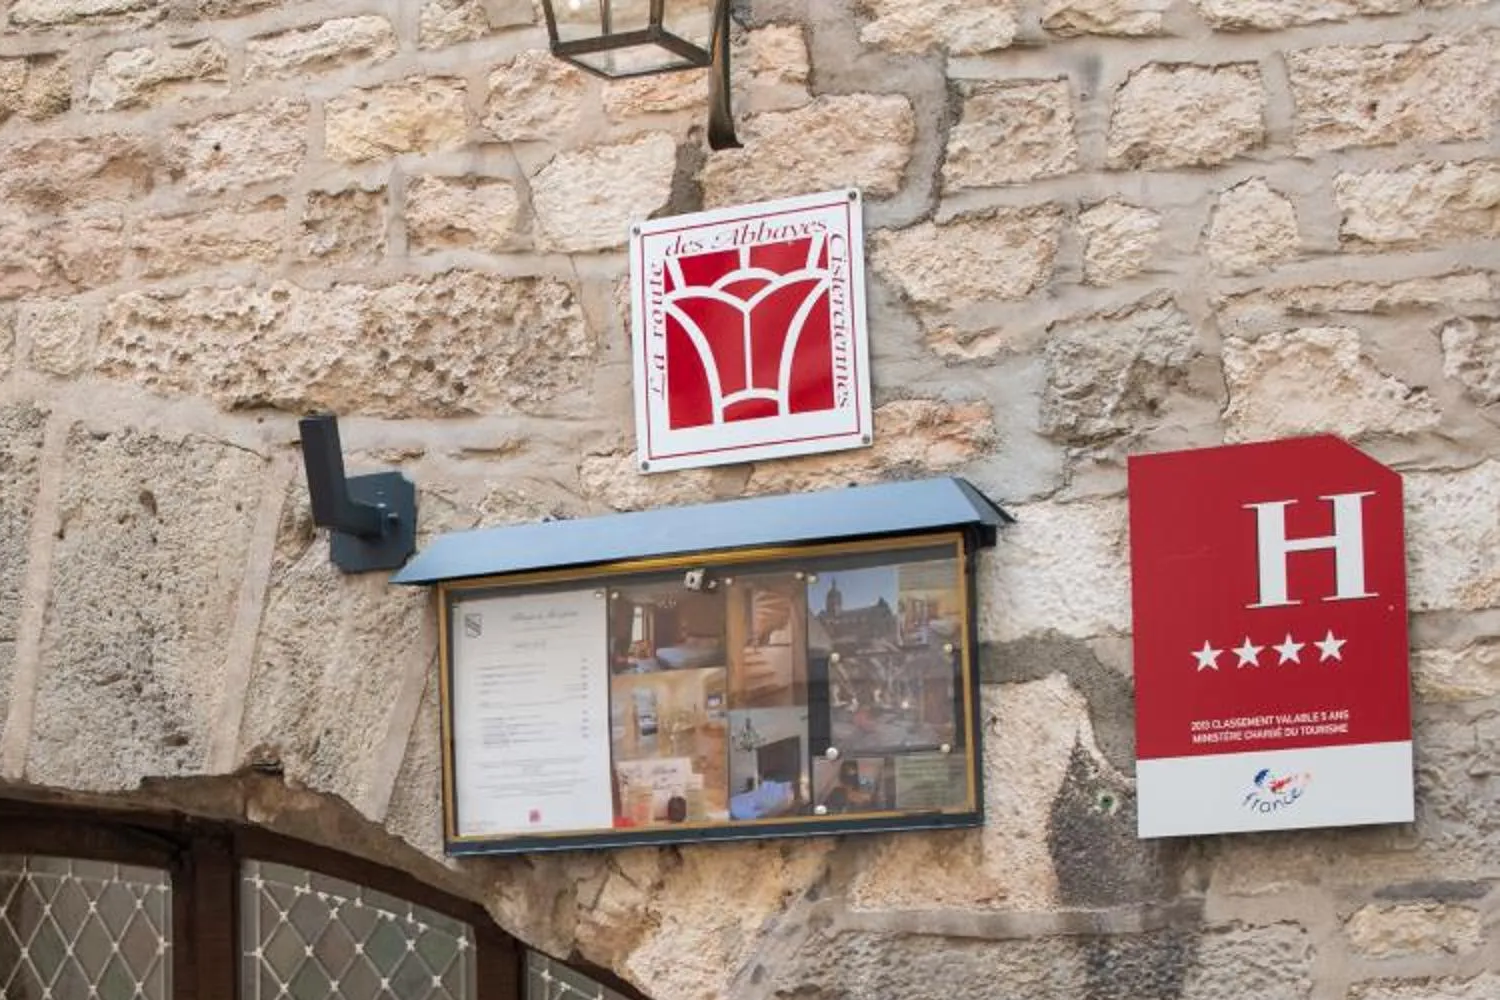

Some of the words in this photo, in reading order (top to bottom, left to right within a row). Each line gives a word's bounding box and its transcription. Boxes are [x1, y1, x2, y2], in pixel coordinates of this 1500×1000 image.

[665, 235, 704, 257] des
[711, 220, 828, 248] Abbayes
[649, 261, 665, 338] route
[650, 353, 665, 401] La
[1242, 490, 1380, 609] H
[1212, 714, 1273, 730] CLASSEMENT
[1275, 711, 1319, 726] VALABLE
[1328, 709, 1349, 721] ANS
[1284, 726, 1298, 738] DU
[1300, 724, 1348, 736] TOURISME
